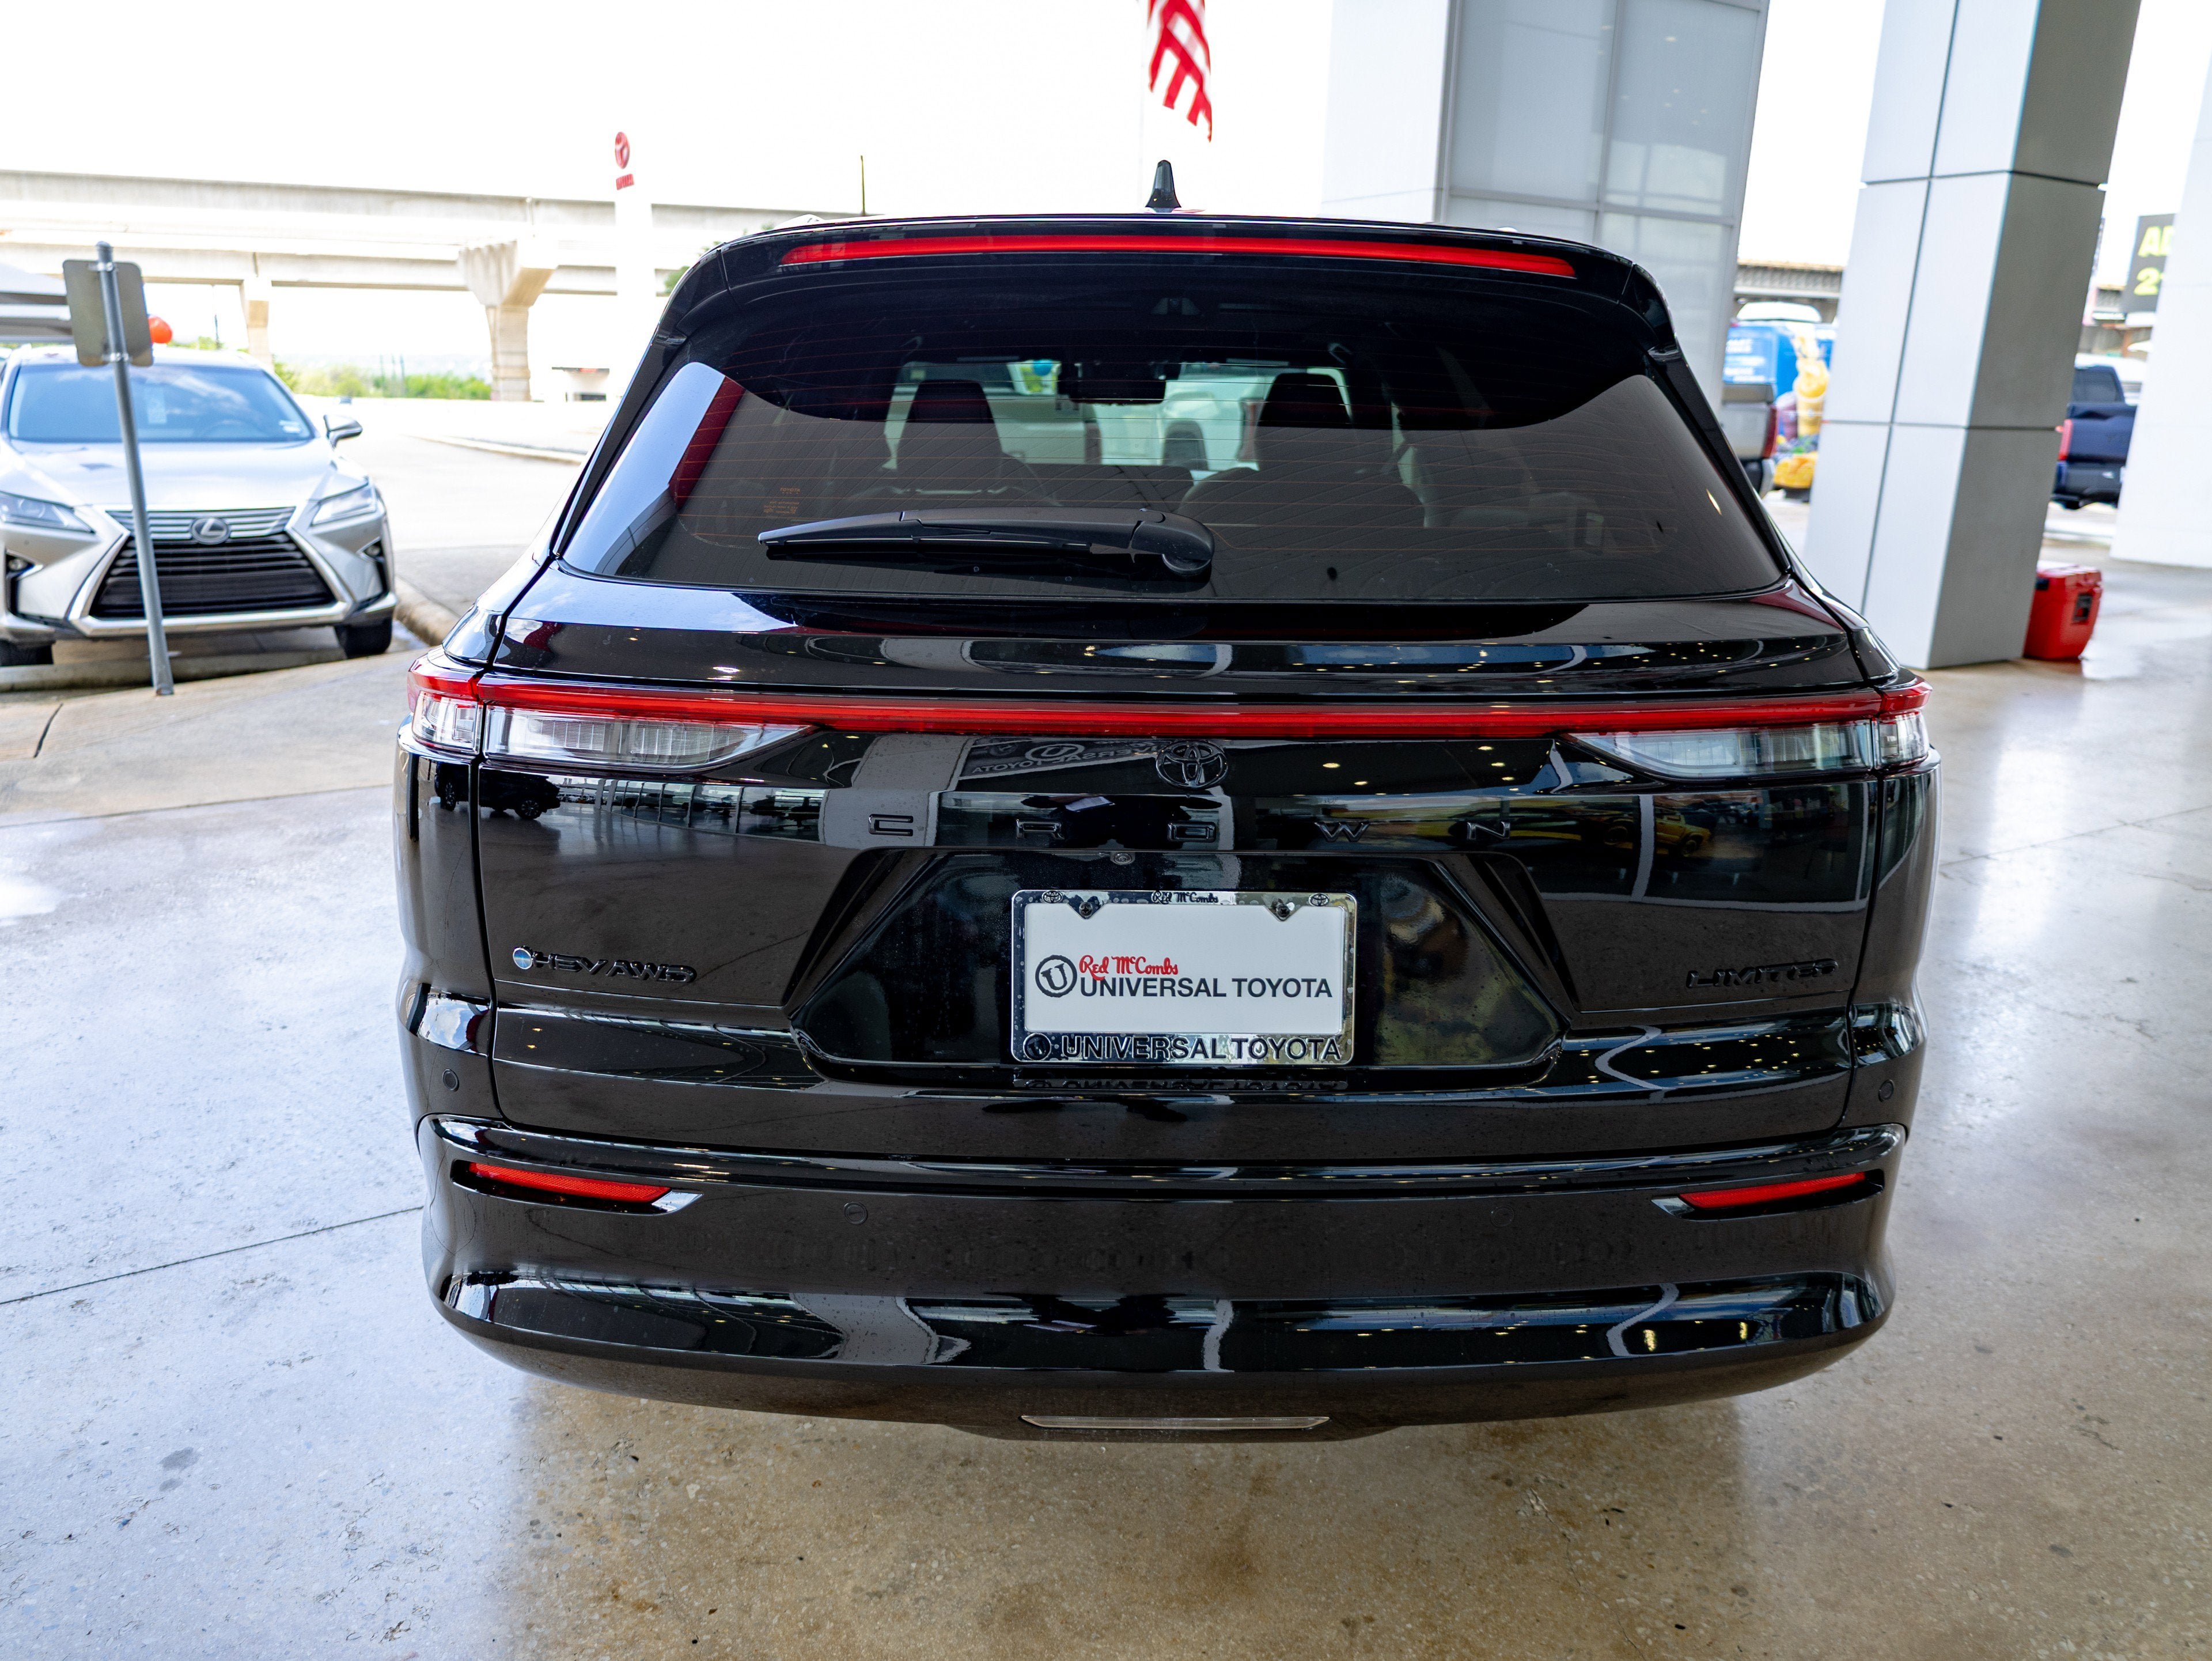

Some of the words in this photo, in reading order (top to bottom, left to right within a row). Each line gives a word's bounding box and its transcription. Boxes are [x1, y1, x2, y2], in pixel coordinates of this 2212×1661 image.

[1152, 890, 1172, 905] Red
[1173, 892, 1219, 903] McCombs
[1079, 955, 1109, 981] Red
[1111, 956, 1179, 975] McCombs
[1080, 977, 1226, 997] UNIVERSAL
[1232, 978, 1333, 998] TOYOTA
[1062, 1035, 1227, 1060] UNIVERSAL
[1232, 1036, 1342, 1061] TOYOTA
